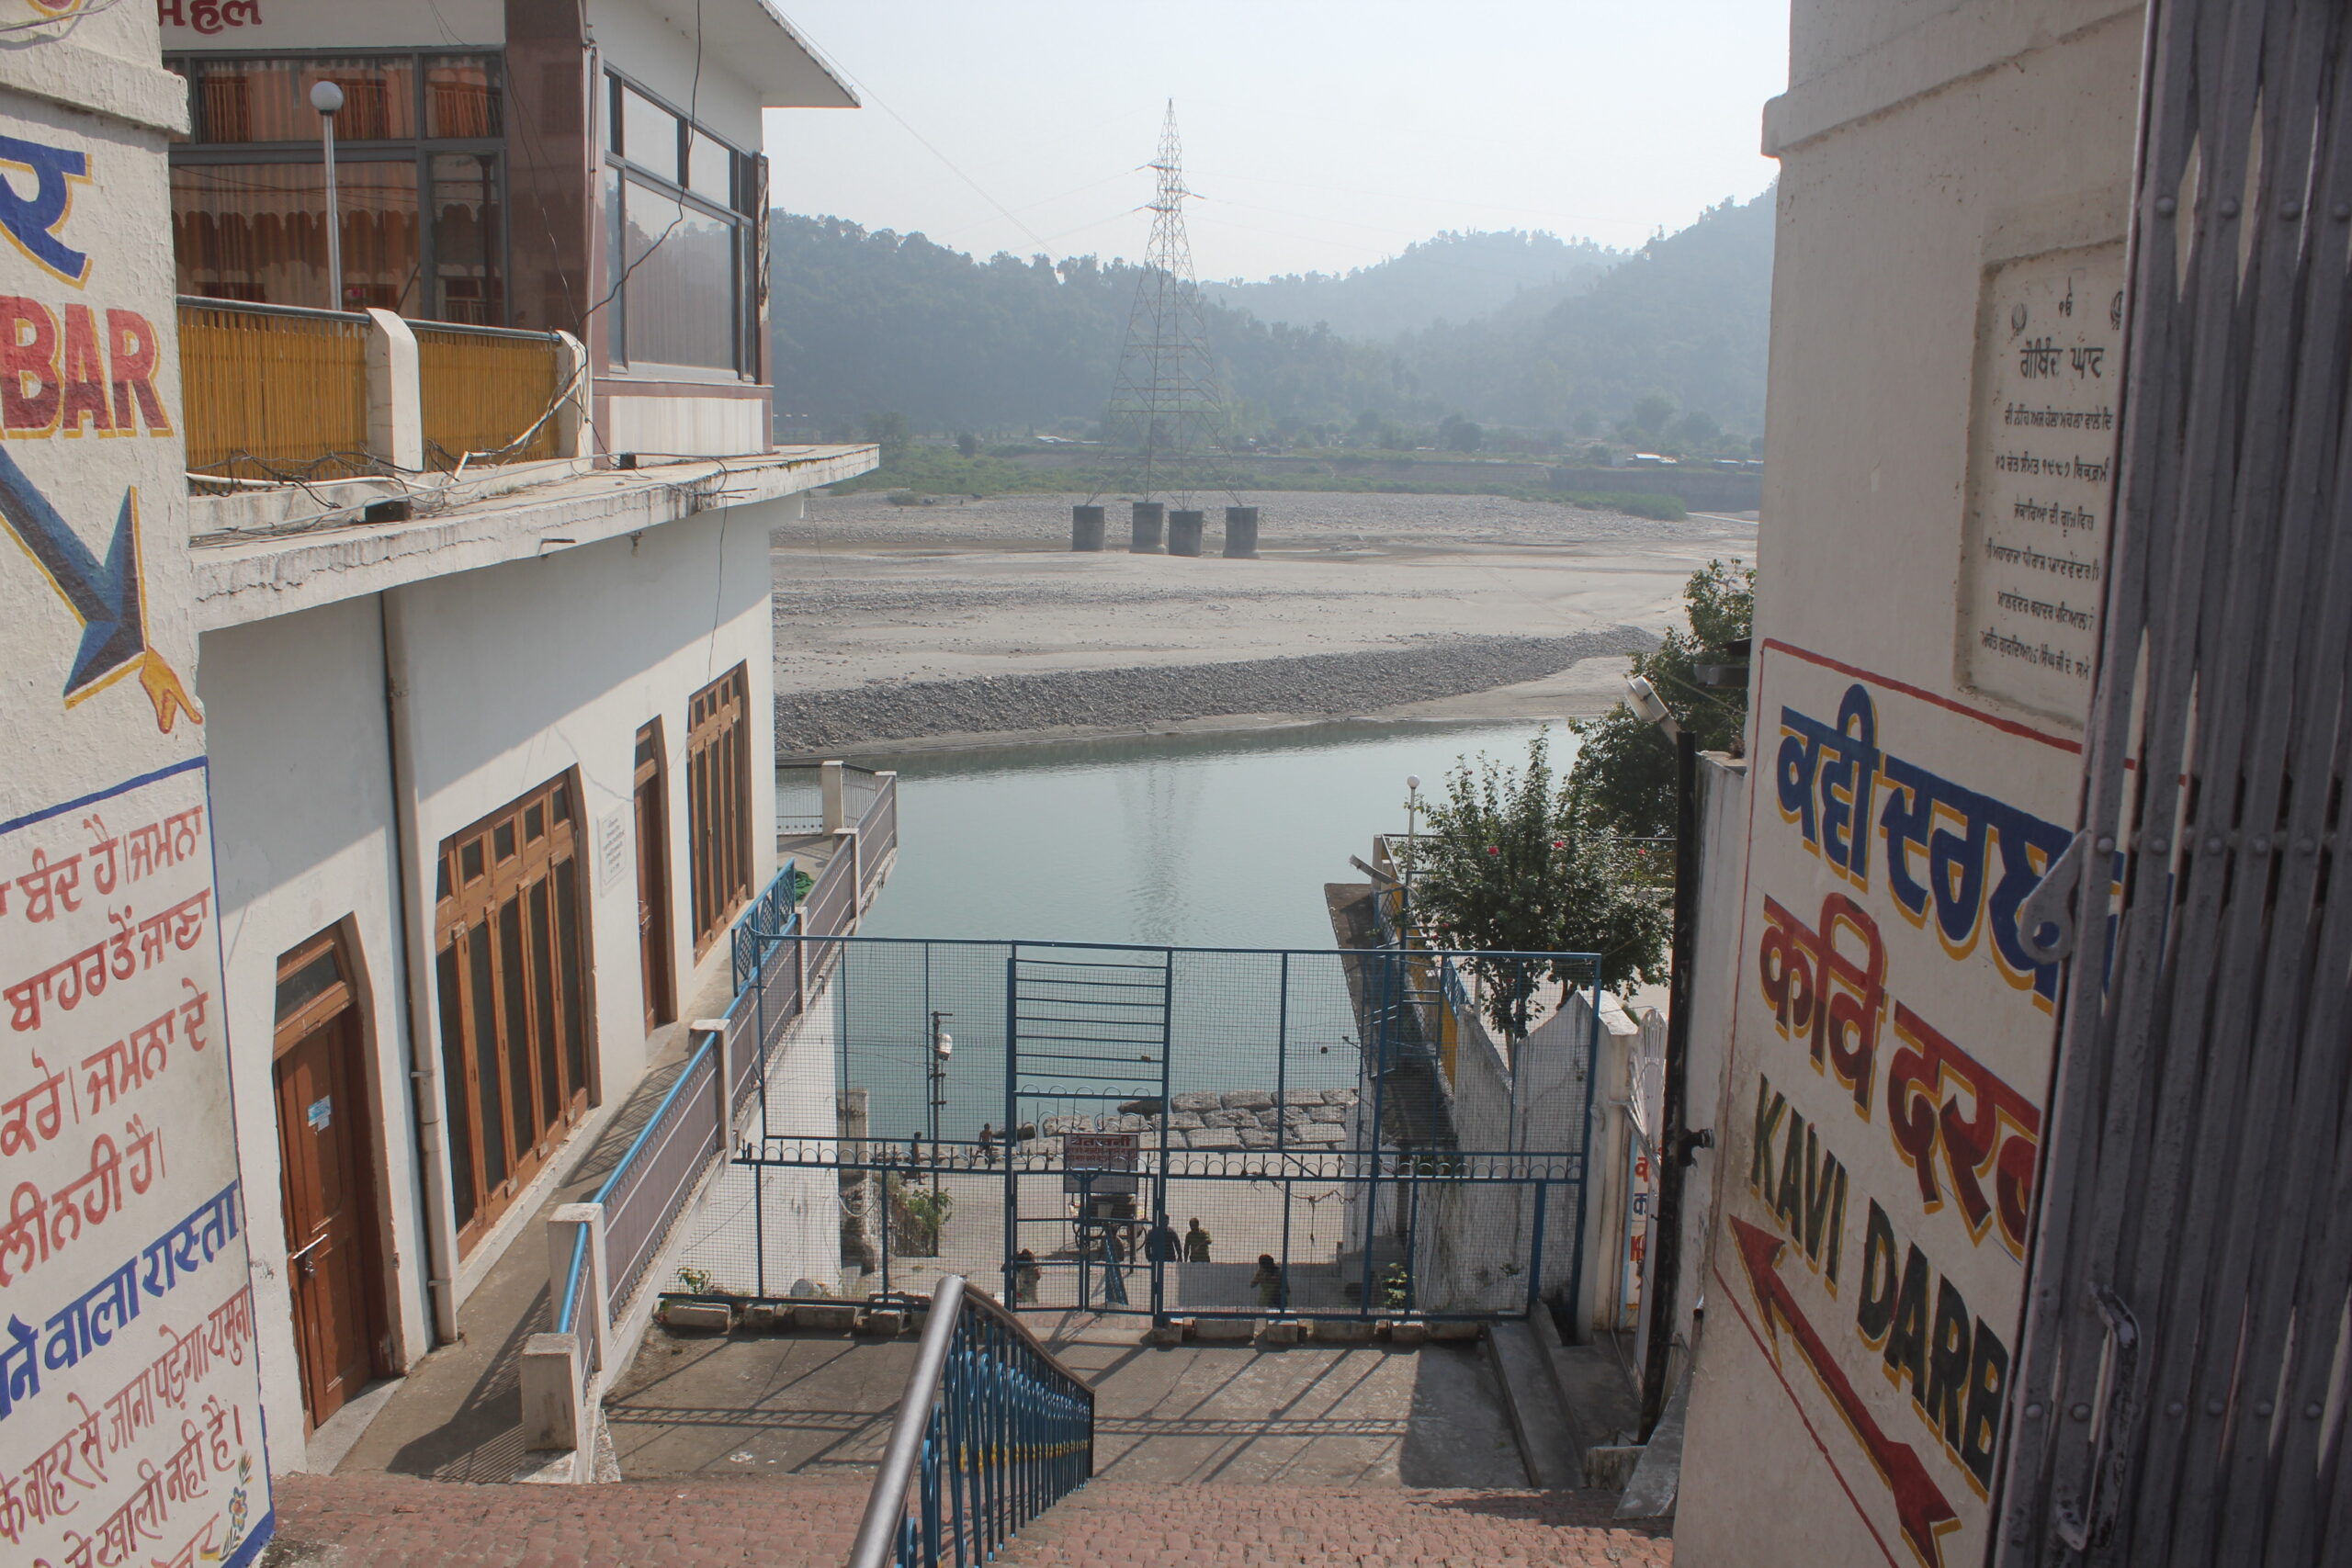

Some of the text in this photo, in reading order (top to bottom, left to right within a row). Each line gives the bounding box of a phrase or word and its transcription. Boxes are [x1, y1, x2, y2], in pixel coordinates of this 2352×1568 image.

[2069, 346, 2105, 379] ਘਾਟ
[129, 805, 203, 882] ਜਮਨਾ
[1776, 683, 1881, 895] ਕਵੀ
[81, 1008, 176, 1116] ਜਮਨਾ
[179, 977, 209, 1052] ਦੇ
[1758, 891, 1890, 1124] कवि
[44, 1255, 141, 1371] वाला
[141, 1179, 240, 1298] रास्ता
[1750, 1072, 1849, 1303] KAVI
[66, 1392, 108, 1483] से
[104, 1367, 155, 1454] जाना
[208, 1282, 252, 1367] यमुना
[96, 1458, 168, 1566] खाली
